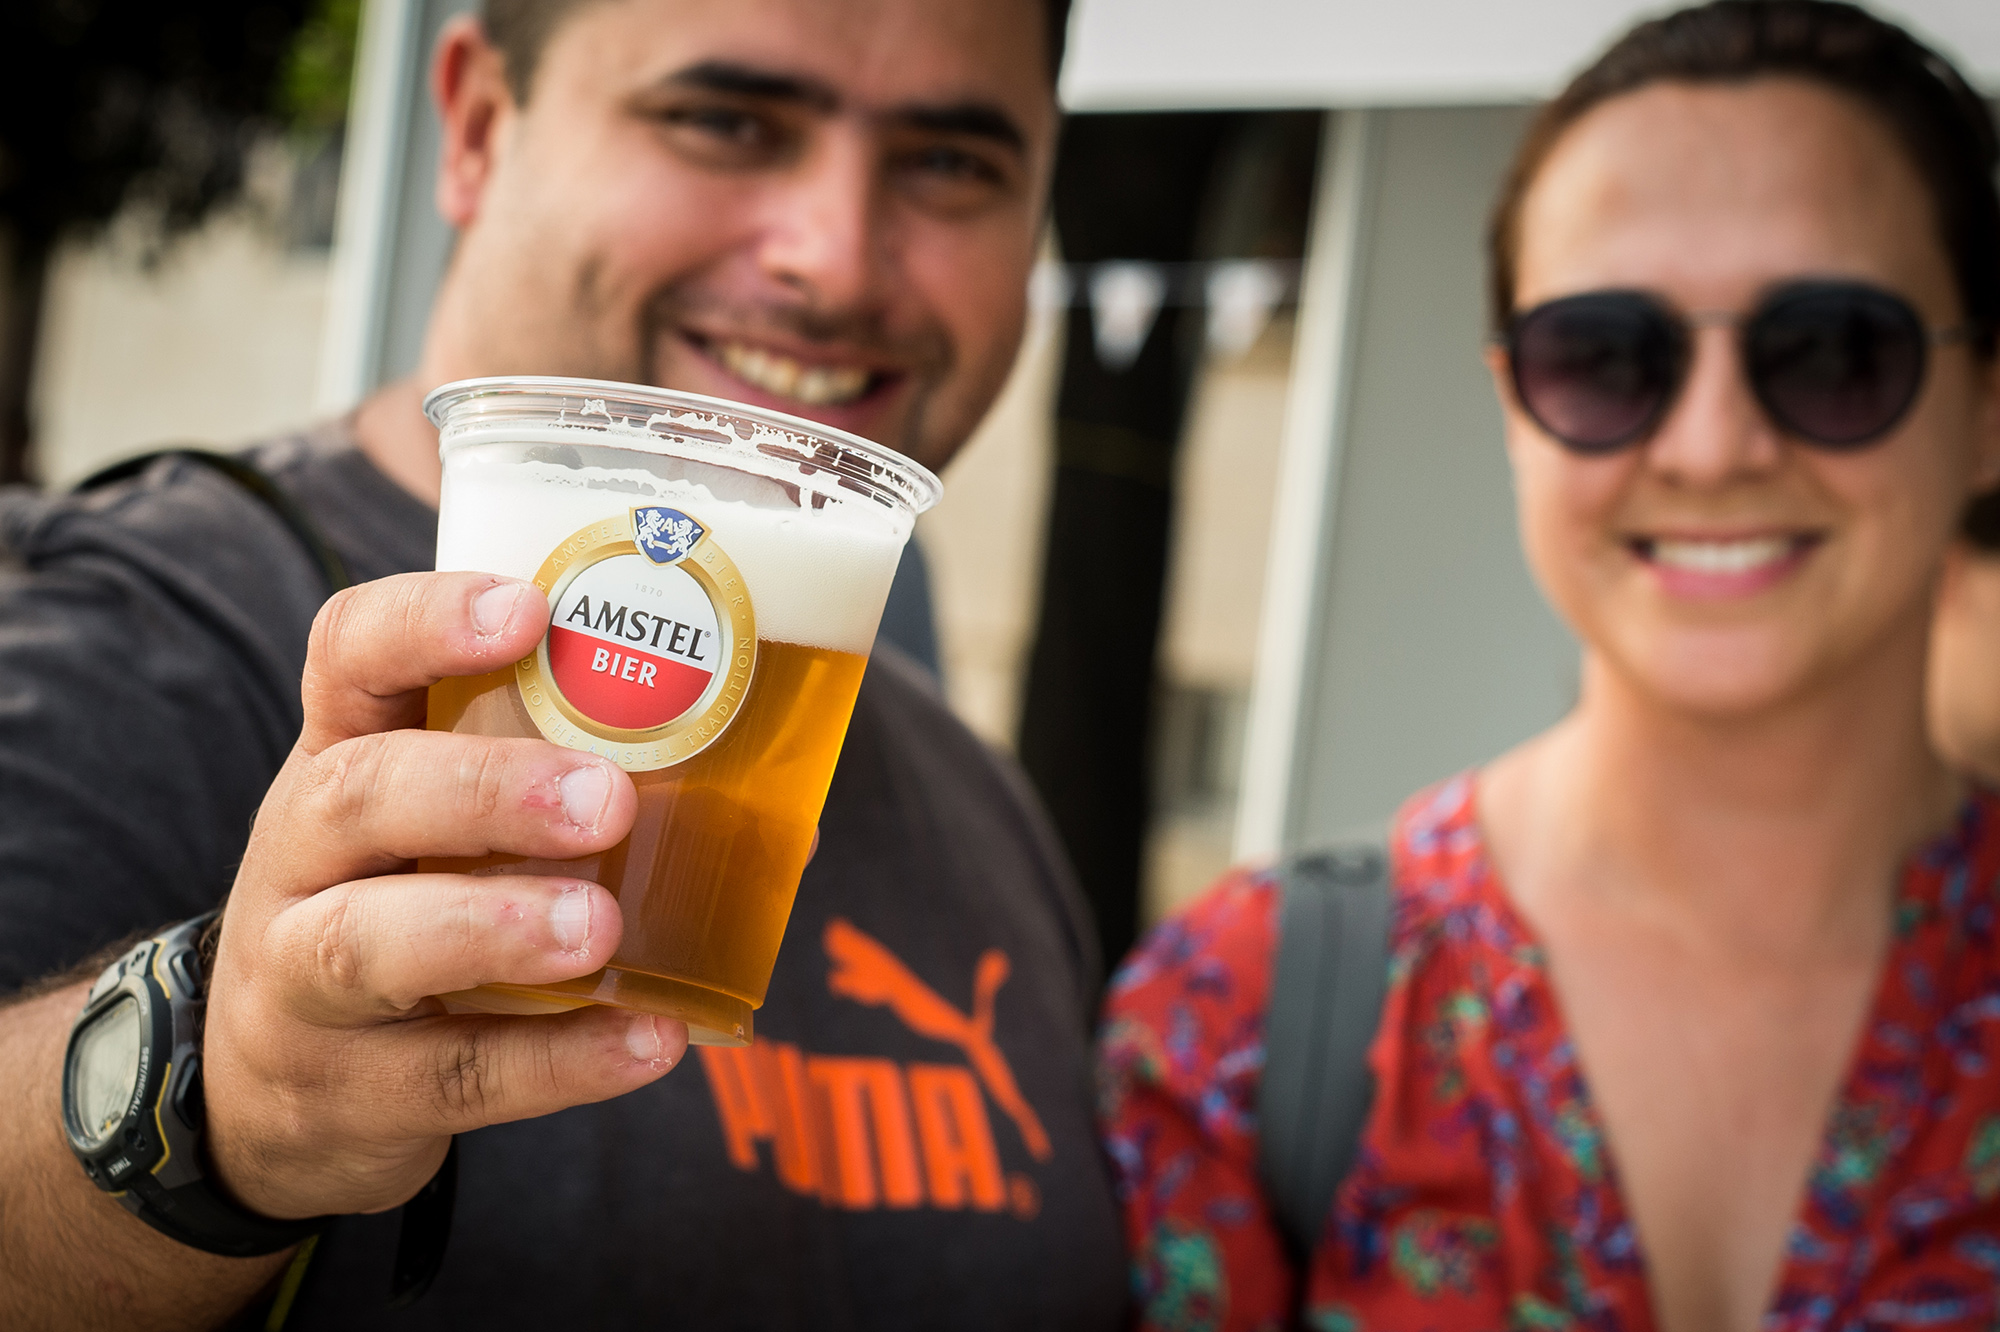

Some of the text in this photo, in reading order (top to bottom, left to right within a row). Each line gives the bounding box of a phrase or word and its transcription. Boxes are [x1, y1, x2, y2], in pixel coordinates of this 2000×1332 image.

[552, 522, 745, 608] AMSTEL BIER
[634, 582, 664, 598] 1870
[566, 594, 706, 662] AMSTEL
[525, 636, 752, 765] TO THE AMSTEL TRADITION
[591, 647, 658, 689] BIER
[128, 1046, 150, 1117] SET/RECALL
[698, 1034, 1007, 1211] PUMA
